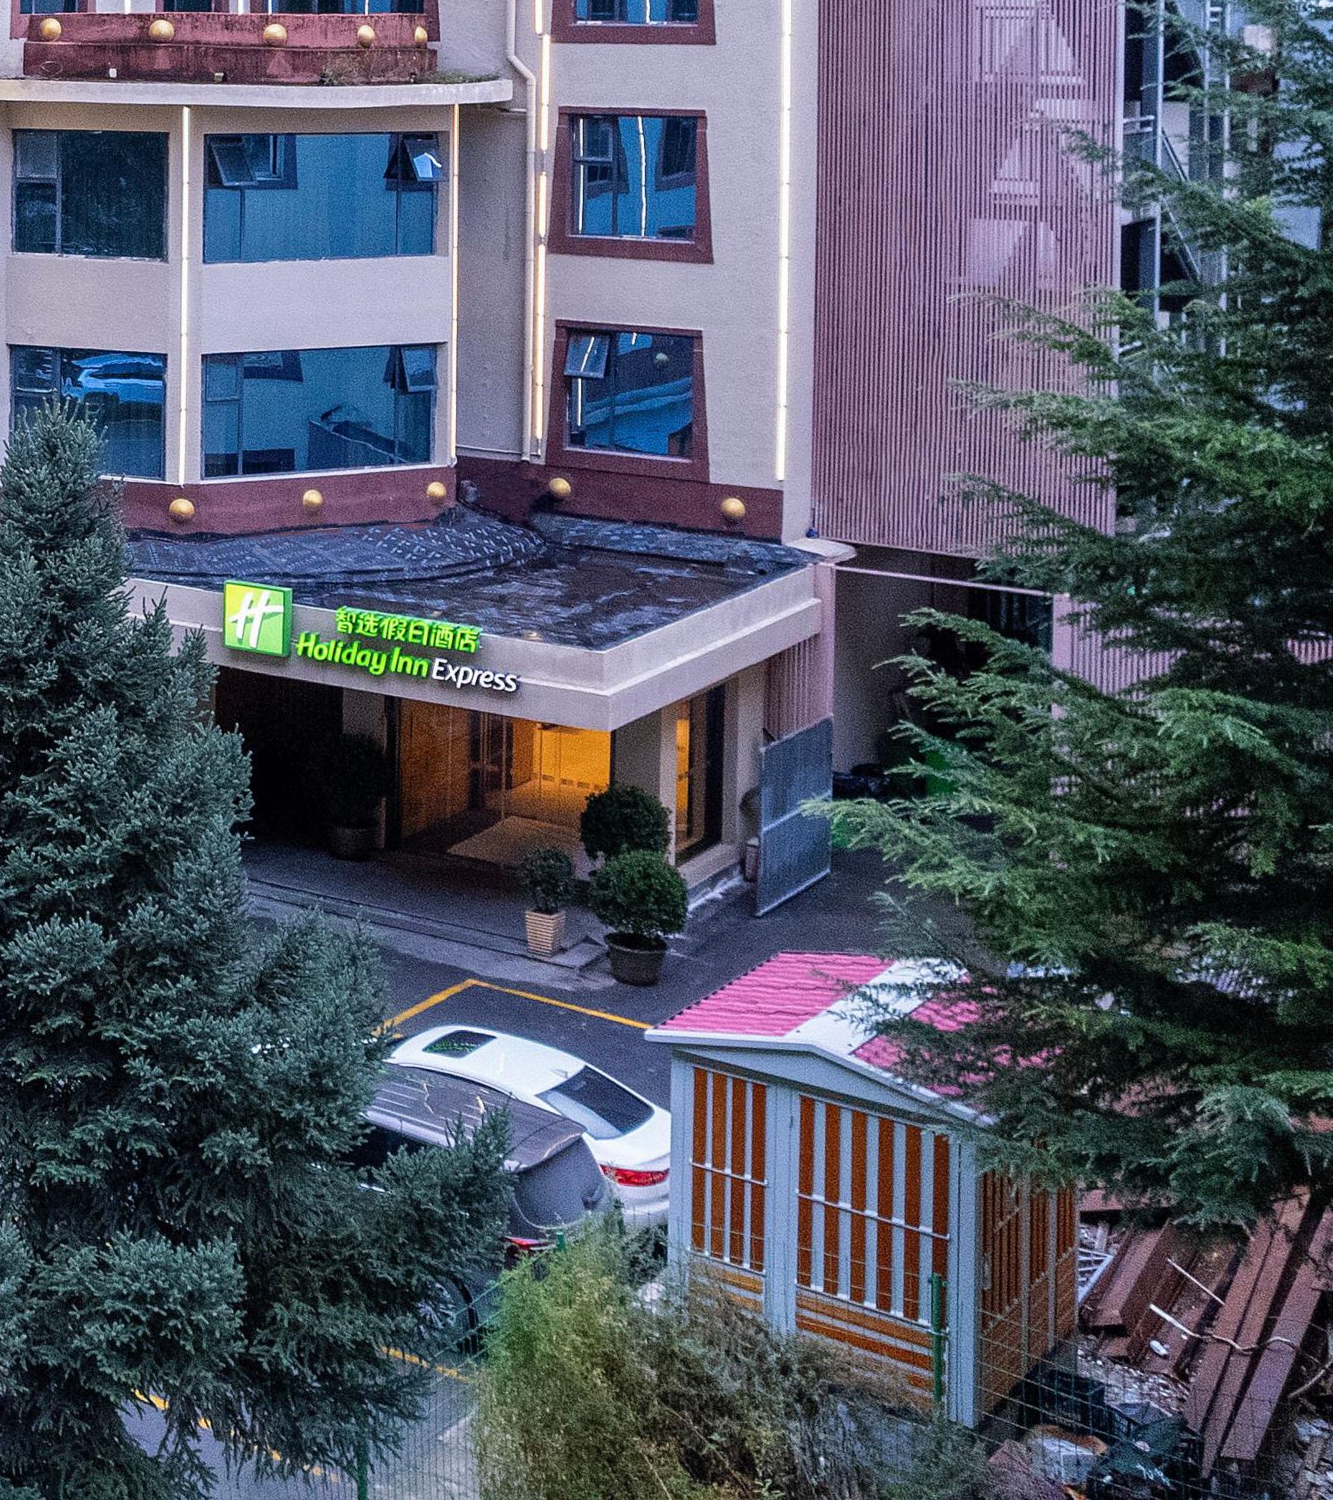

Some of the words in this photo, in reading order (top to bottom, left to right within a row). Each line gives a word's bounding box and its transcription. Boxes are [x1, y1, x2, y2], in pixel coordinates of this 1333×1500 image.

[335, 606, 483, 653] 智选假日酒店
[296, 632, 388, 676] Holiday
[390, 647, 430, 678] Inn
[431, 658, 519, 693] Express
